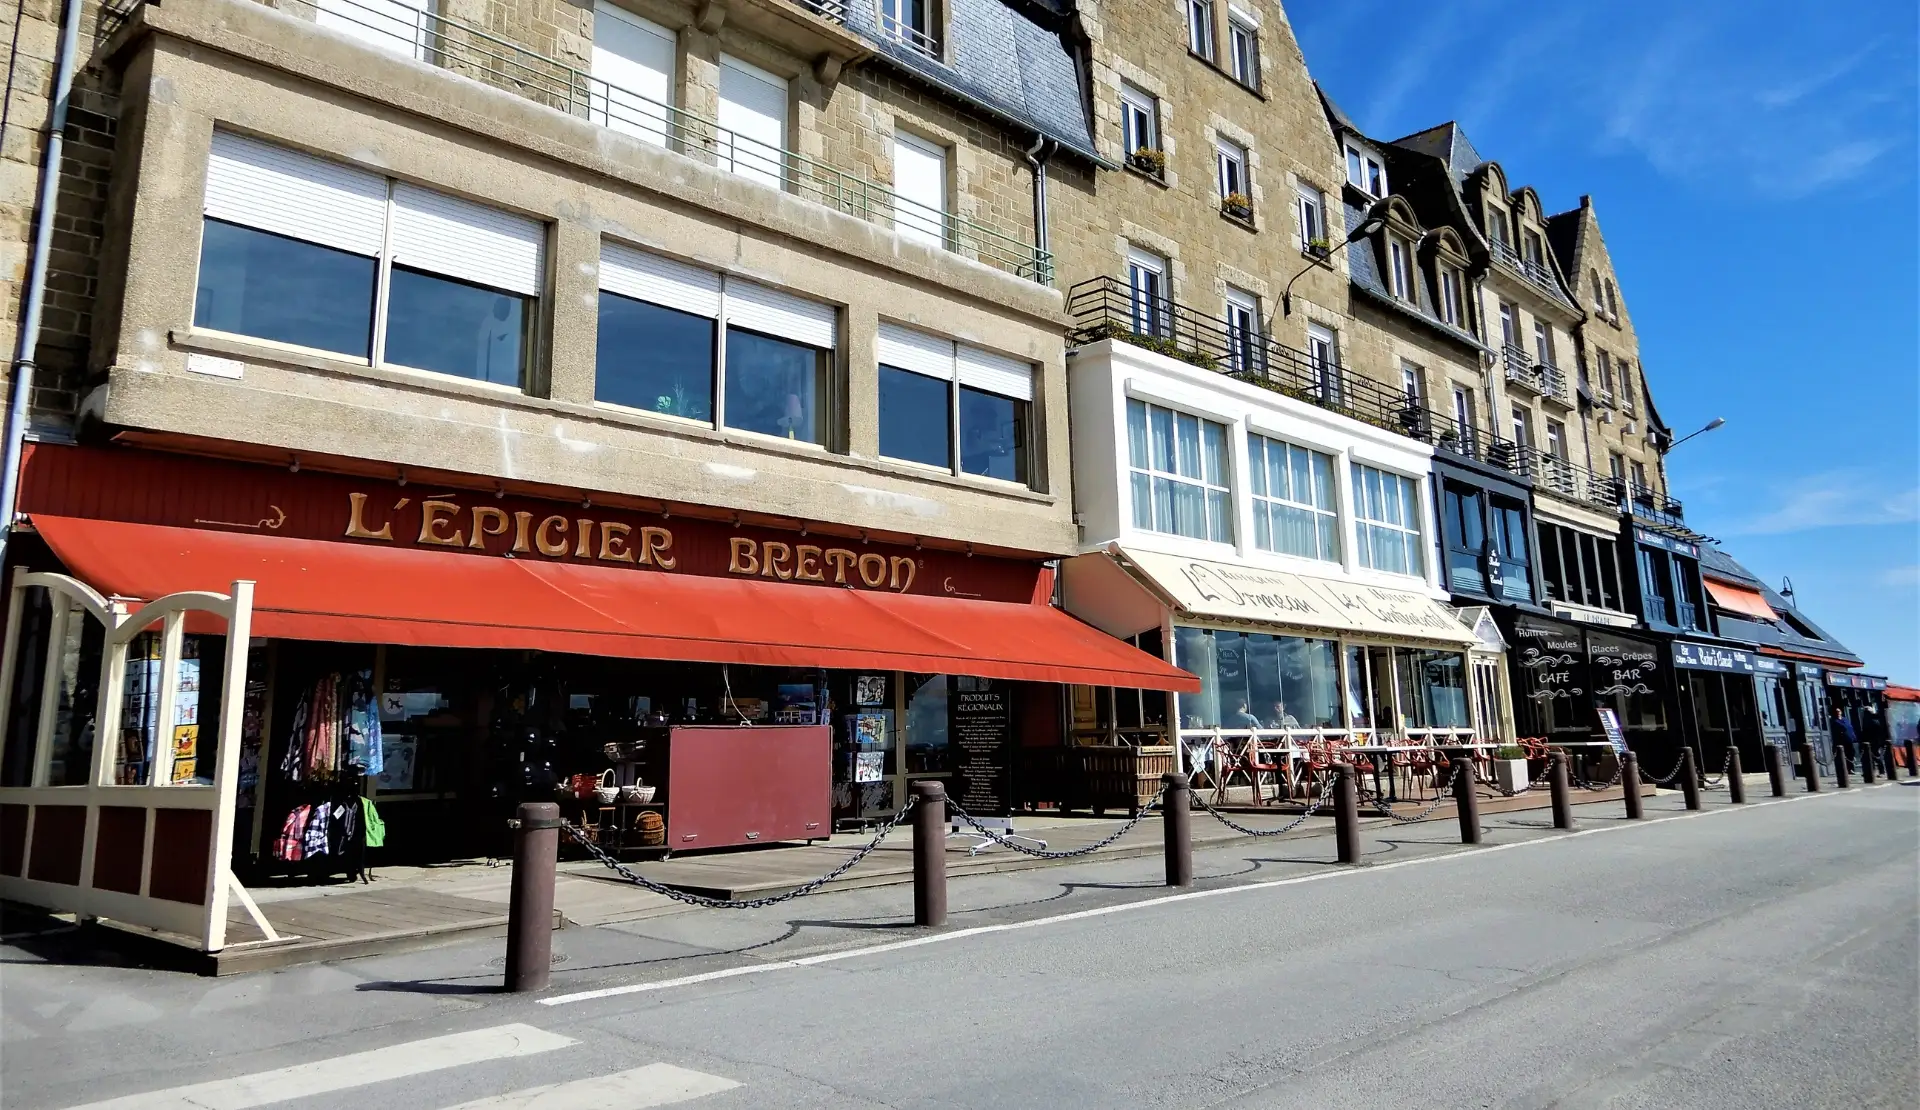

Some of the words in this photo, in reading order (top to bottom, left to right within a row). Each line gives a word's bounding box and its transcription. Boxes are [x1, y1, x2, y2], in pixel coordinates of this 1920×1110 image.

[728, 537, 916, 594] BRETON
[1547, 640, 1578, 650] Moules
[1591, 645, 1620, 654] Glaces
[1622, 652, 1653, 662] Crêpes
[1539, 670, 1570, 684] CAFÉ
[1612, 669, 1641, 681] BAR
[960, 693, 1001, 702] PRODUITS
[957, 703, 1004, 712] RÉGIONAUX
